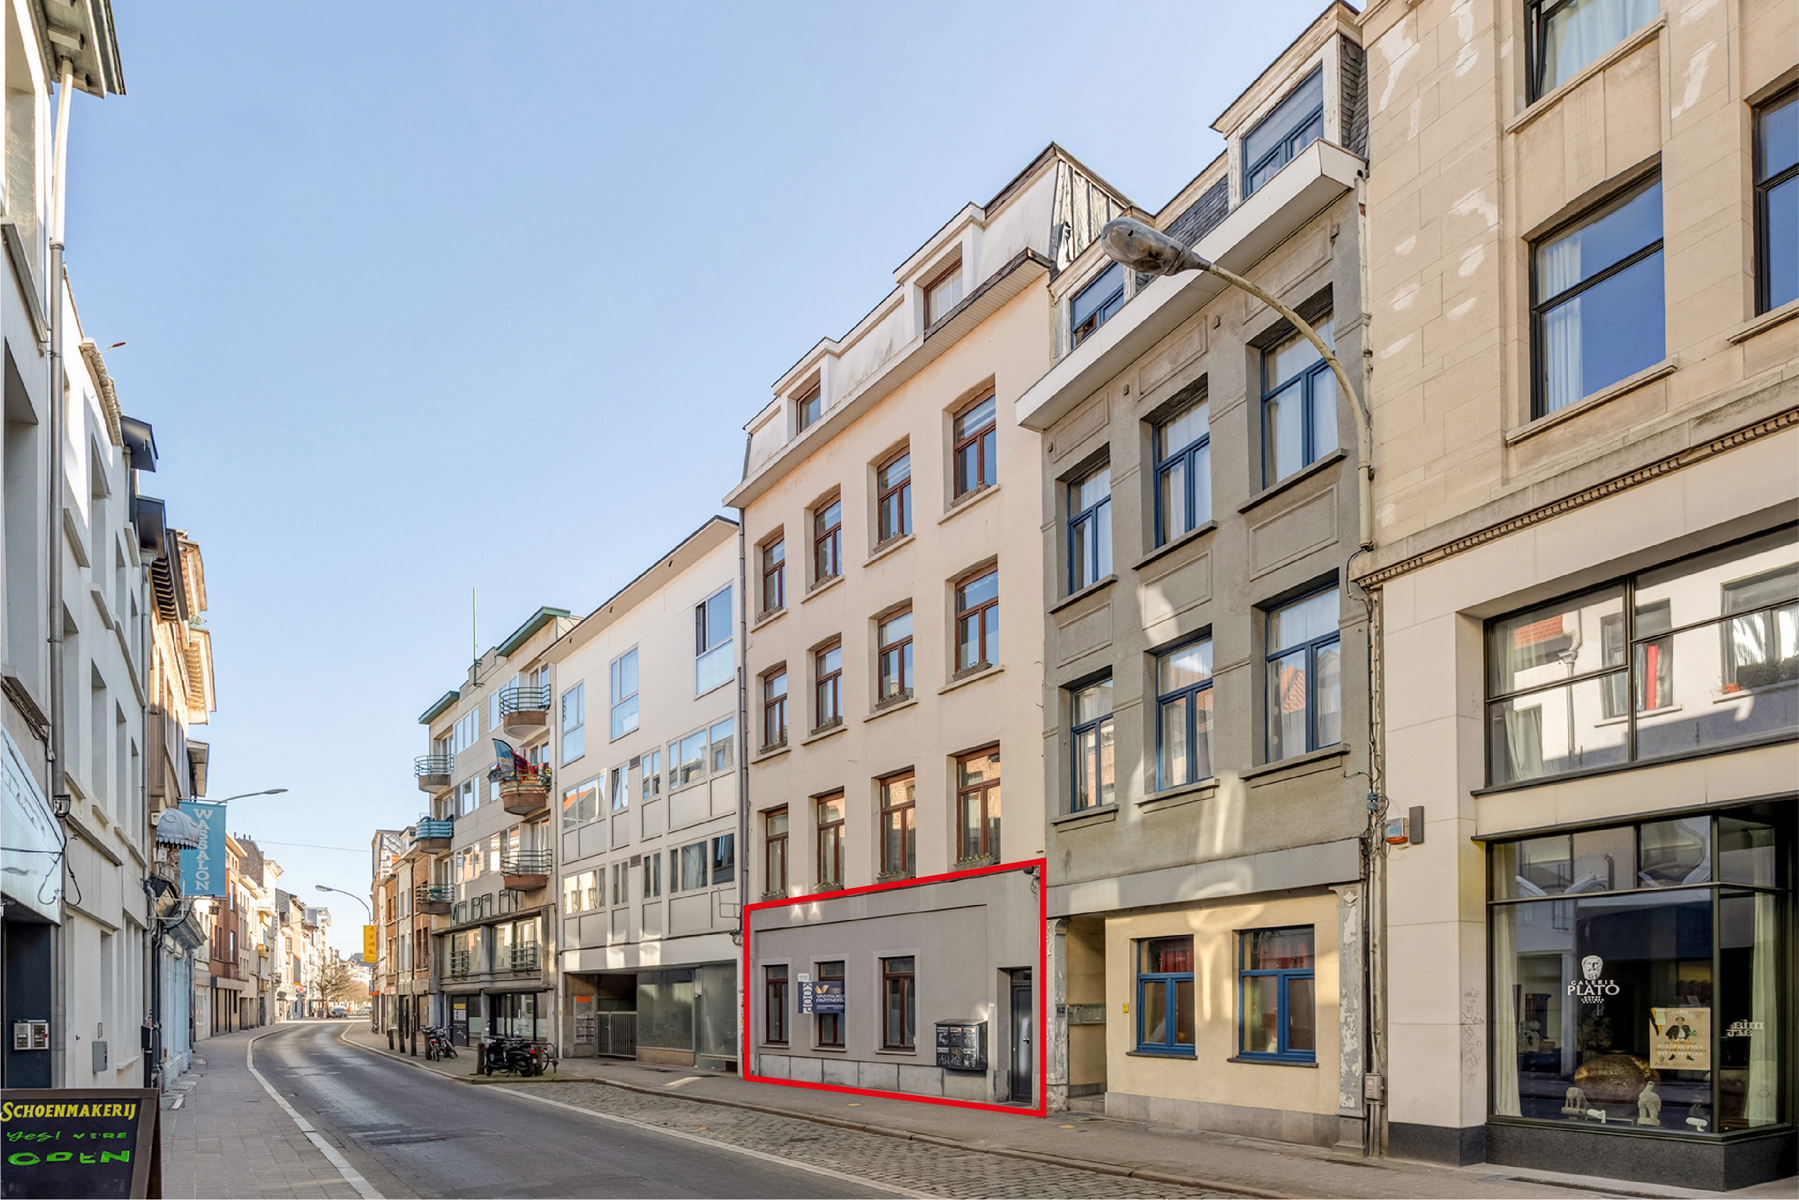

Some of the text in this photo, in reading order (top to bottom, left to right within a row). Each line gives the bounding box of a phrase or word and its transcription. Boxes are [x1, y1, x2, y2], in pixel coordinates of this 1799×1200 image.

[193, 808, 214, 891] WASSALON
[802, 982, 813, 1013] KOOP
[1567, 985, 1620, 995] PLATO
[1, 1101, 136, 1122] SCHOENMAKERIJ
[7, 1150, 130, 1166] OPEN
